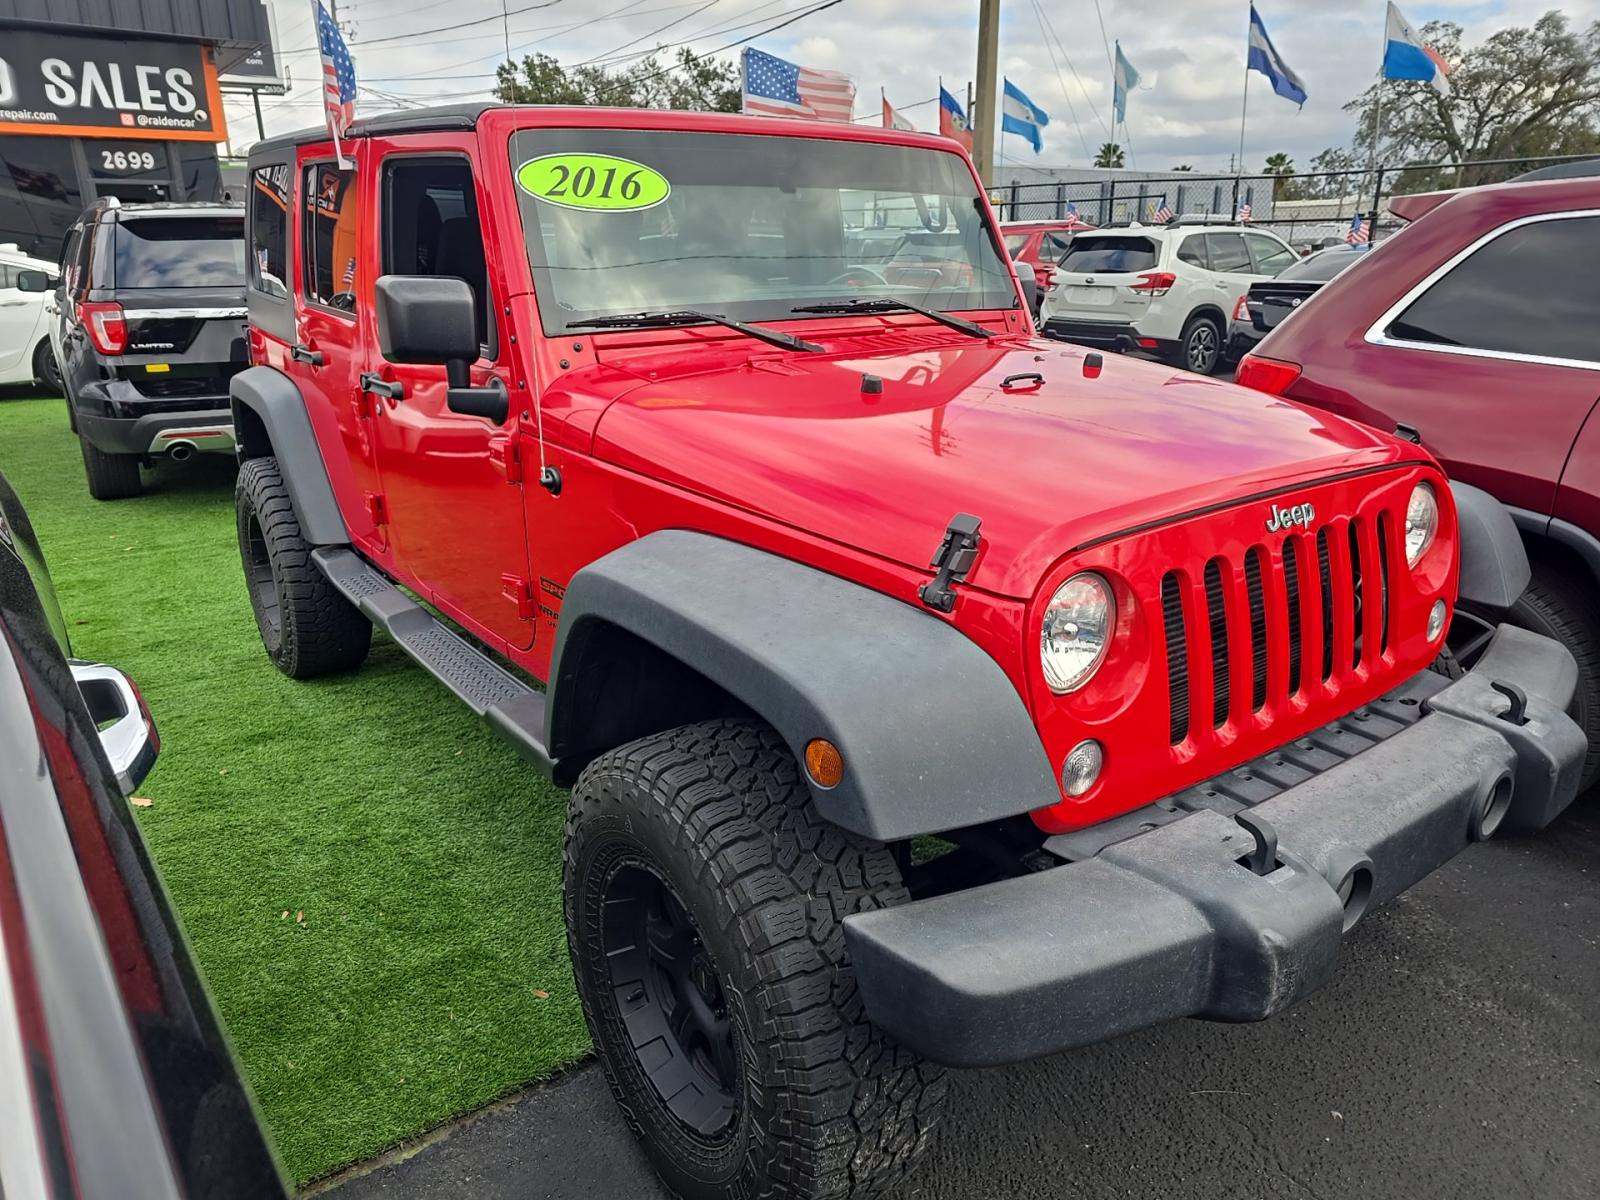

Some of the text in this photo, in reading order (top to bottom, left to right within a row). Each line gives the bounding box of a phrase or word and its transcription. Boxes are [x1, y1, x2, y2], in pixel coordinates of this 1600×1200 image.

[41, 58, 196, 113] SALES
[102, 150, 155, 170] 2699
[545, 165, 644, 200] 2016
[1266, 502, 1315, 533] Jeep
